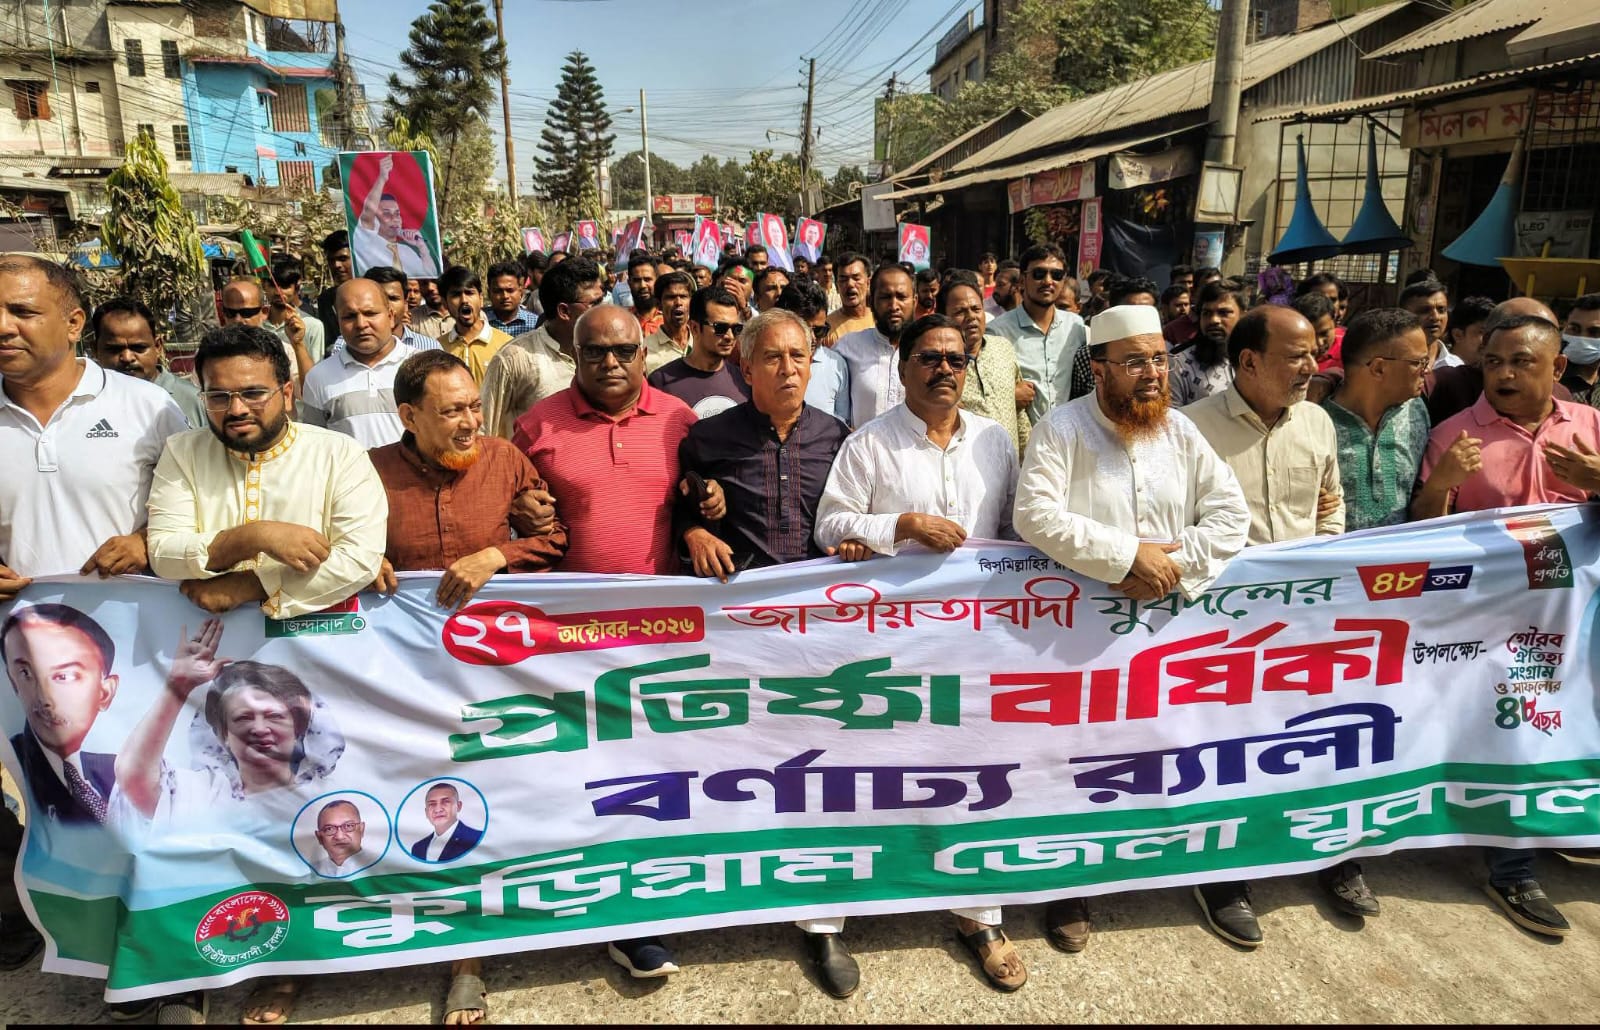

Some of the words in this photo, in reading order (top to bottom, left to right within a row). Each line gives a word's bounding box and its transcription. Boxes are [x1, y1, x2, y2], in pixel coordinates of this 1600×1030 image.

[86, 430, 119, 439] adidas
[1372, 571, 1424, 594] ৪৮
[1431, 573, 1467, 586] তম
[721, 576, 1081, 634] জাতীয়তাবাদী
[1090, 576, 1342, 636] যুবদলের
[282, 617, 346, 633] জিন্দাবাদ
[449, 610, 536, 658] ২৭
[556, 618, 696, 645] অক্টোবর-২০২৬
[1506, 626, 1566, 653] গৌরব
[1513, 646, 1565, 666] ঐতিহ্য
[1507, 664, 1558, 681] সংগ্রাম
[448, 653, 961, 762] প্রতিষ্ঠা
[989, 618, 1411, 726] বার্ষিকী
[1493, 683, 1508, 695] ও
[585, 748, 1020, 822] বর্ণাঢ্য
[303, 843, 884, 949] কুড়িগ্রাম
[933, 816, 1248, 875] জেলা
[215, 893, 268, 916] বাংলাদেশ
[202, 943, 263, 964] জাতীয়তাবাদী
[262, 925, 287, 952] যুবদল
